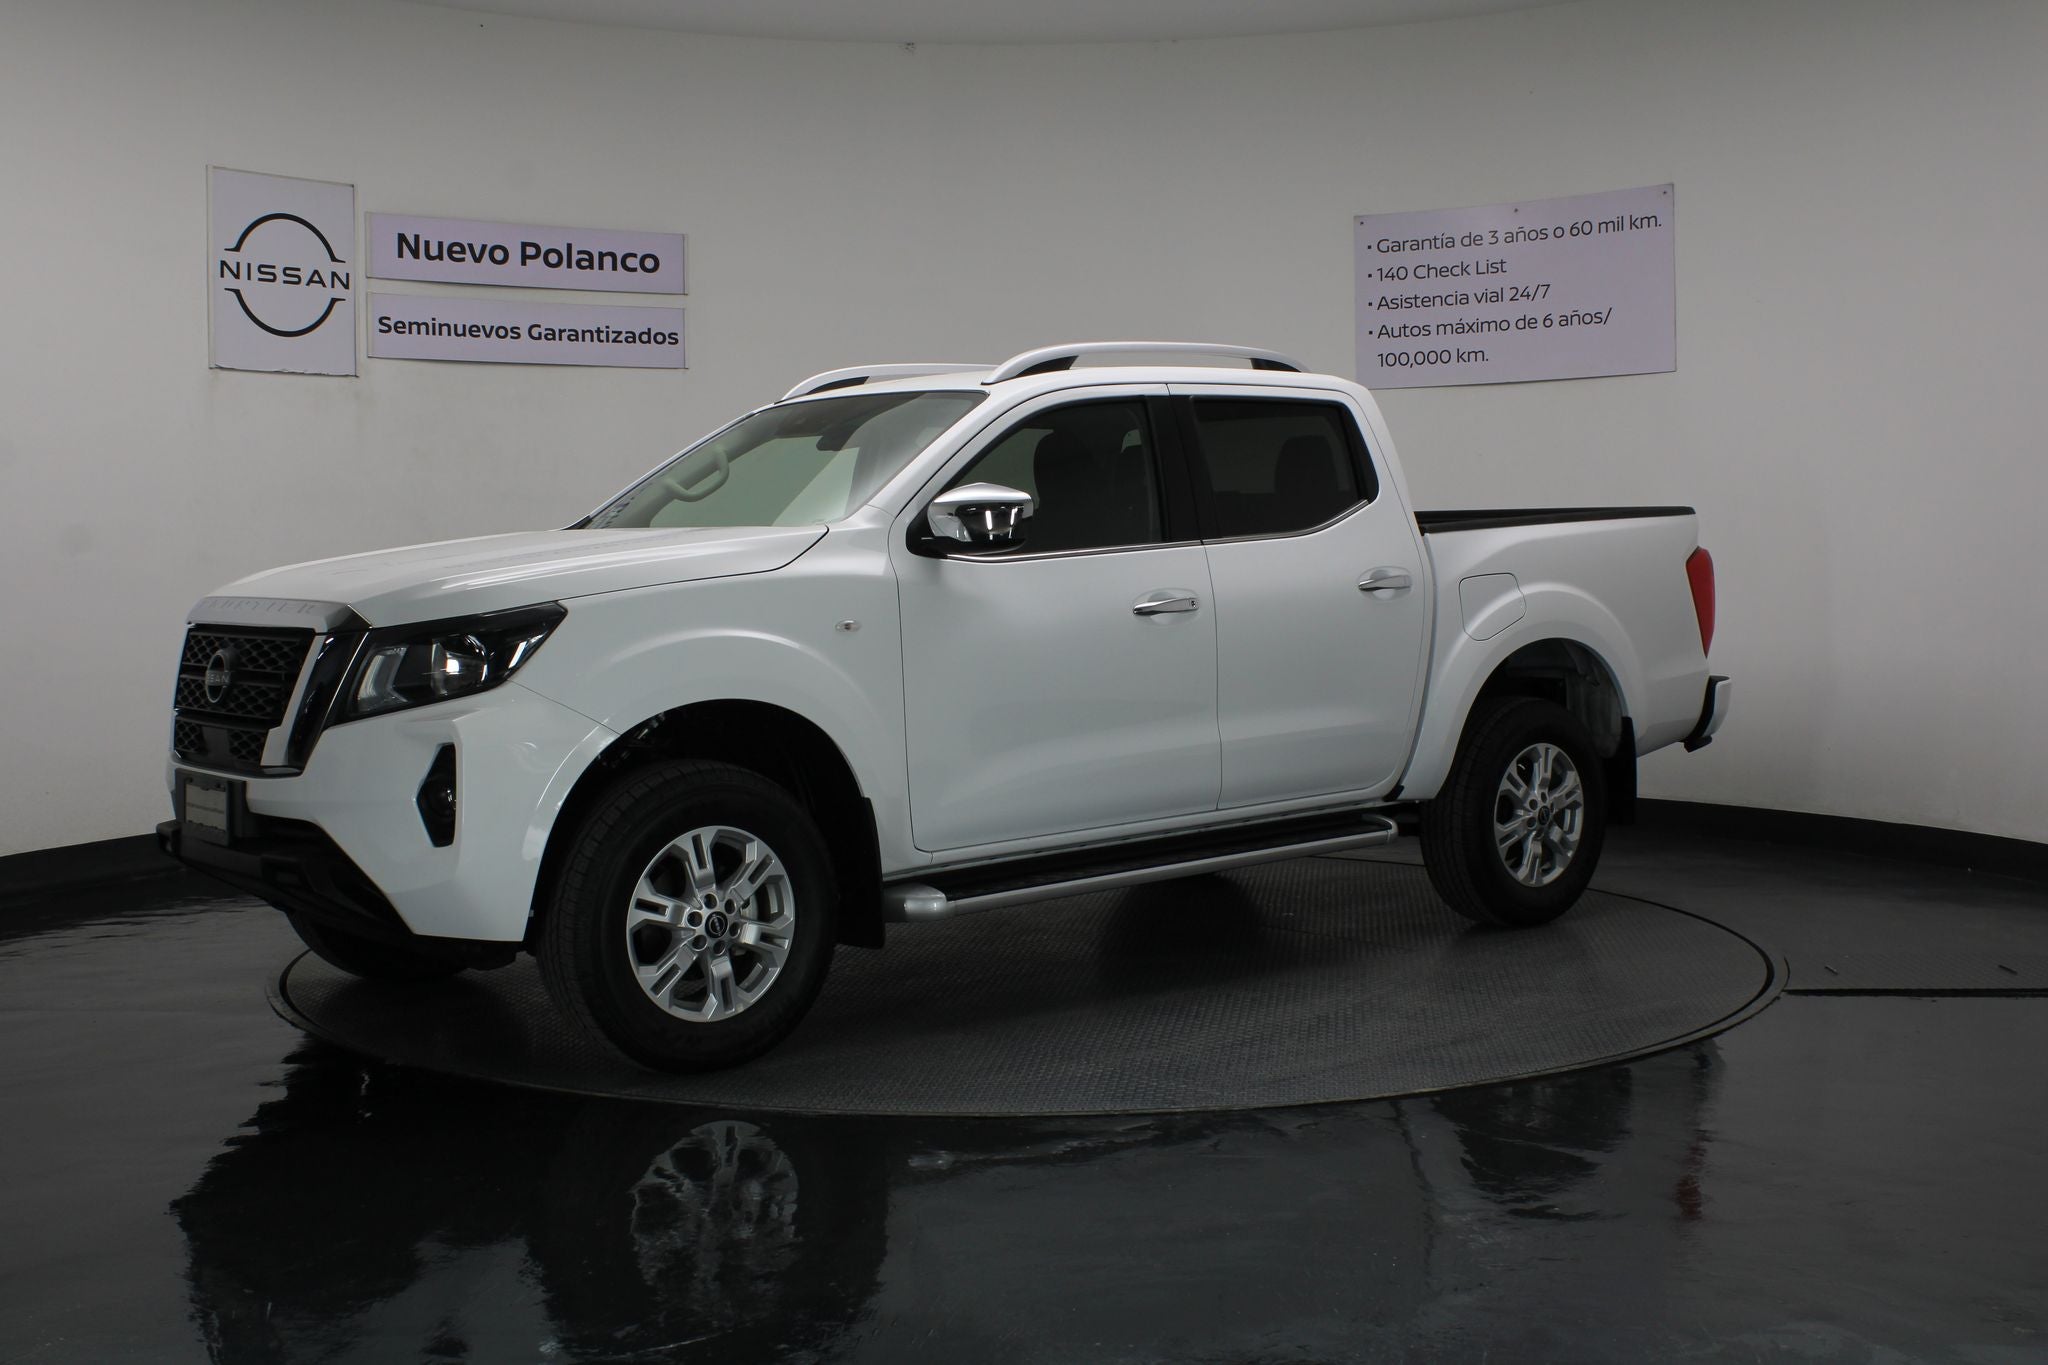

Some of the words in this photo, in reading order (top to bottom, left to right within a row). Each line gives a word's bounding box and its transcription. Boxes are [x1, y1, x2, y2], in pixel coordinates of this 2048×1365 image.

[1376, 232, 1456, 254] Garantía
[1460, 231, 1484, 248] de
[1488, 229, 1499, 246] 3
[1503, 226, 1549, 244] años
[1552, 226, 1565, 239] o
[1569, 220, 1593, 237] 60
[1598, 215, 1624, 234] mil
[1629, 214, 1662, 231] km.
[397, 232, 510, 266] Nuevo
[520, 241, 661, 274] Polanco
[219, 259, 350, 290] NISSAN
[1376, 265, 1409, 282] 140
[1413, 260, 1471, 280] Check
[1475, 258, 1508, 275] List
[1376, 290, 1470, 311] Asistencia
[1473, 287, 1504, 304] vial
[1509, 283, 1551, 302] 24/7
[378, 315, 522, 340] Seminuevos
[527, 323, 679, 346] Garantizados
[1377, 323, 1432, 340] Autos
[1436, 317, 1511, 336] máximo
[1514, 314, 1538, 331] de
[1542, 312, 1554, 329] 6
[1558, 307, 1613, 327] años/
[1377, 349, 1452, 369] 100,000
[1456, 347, 1489, 364] km.
